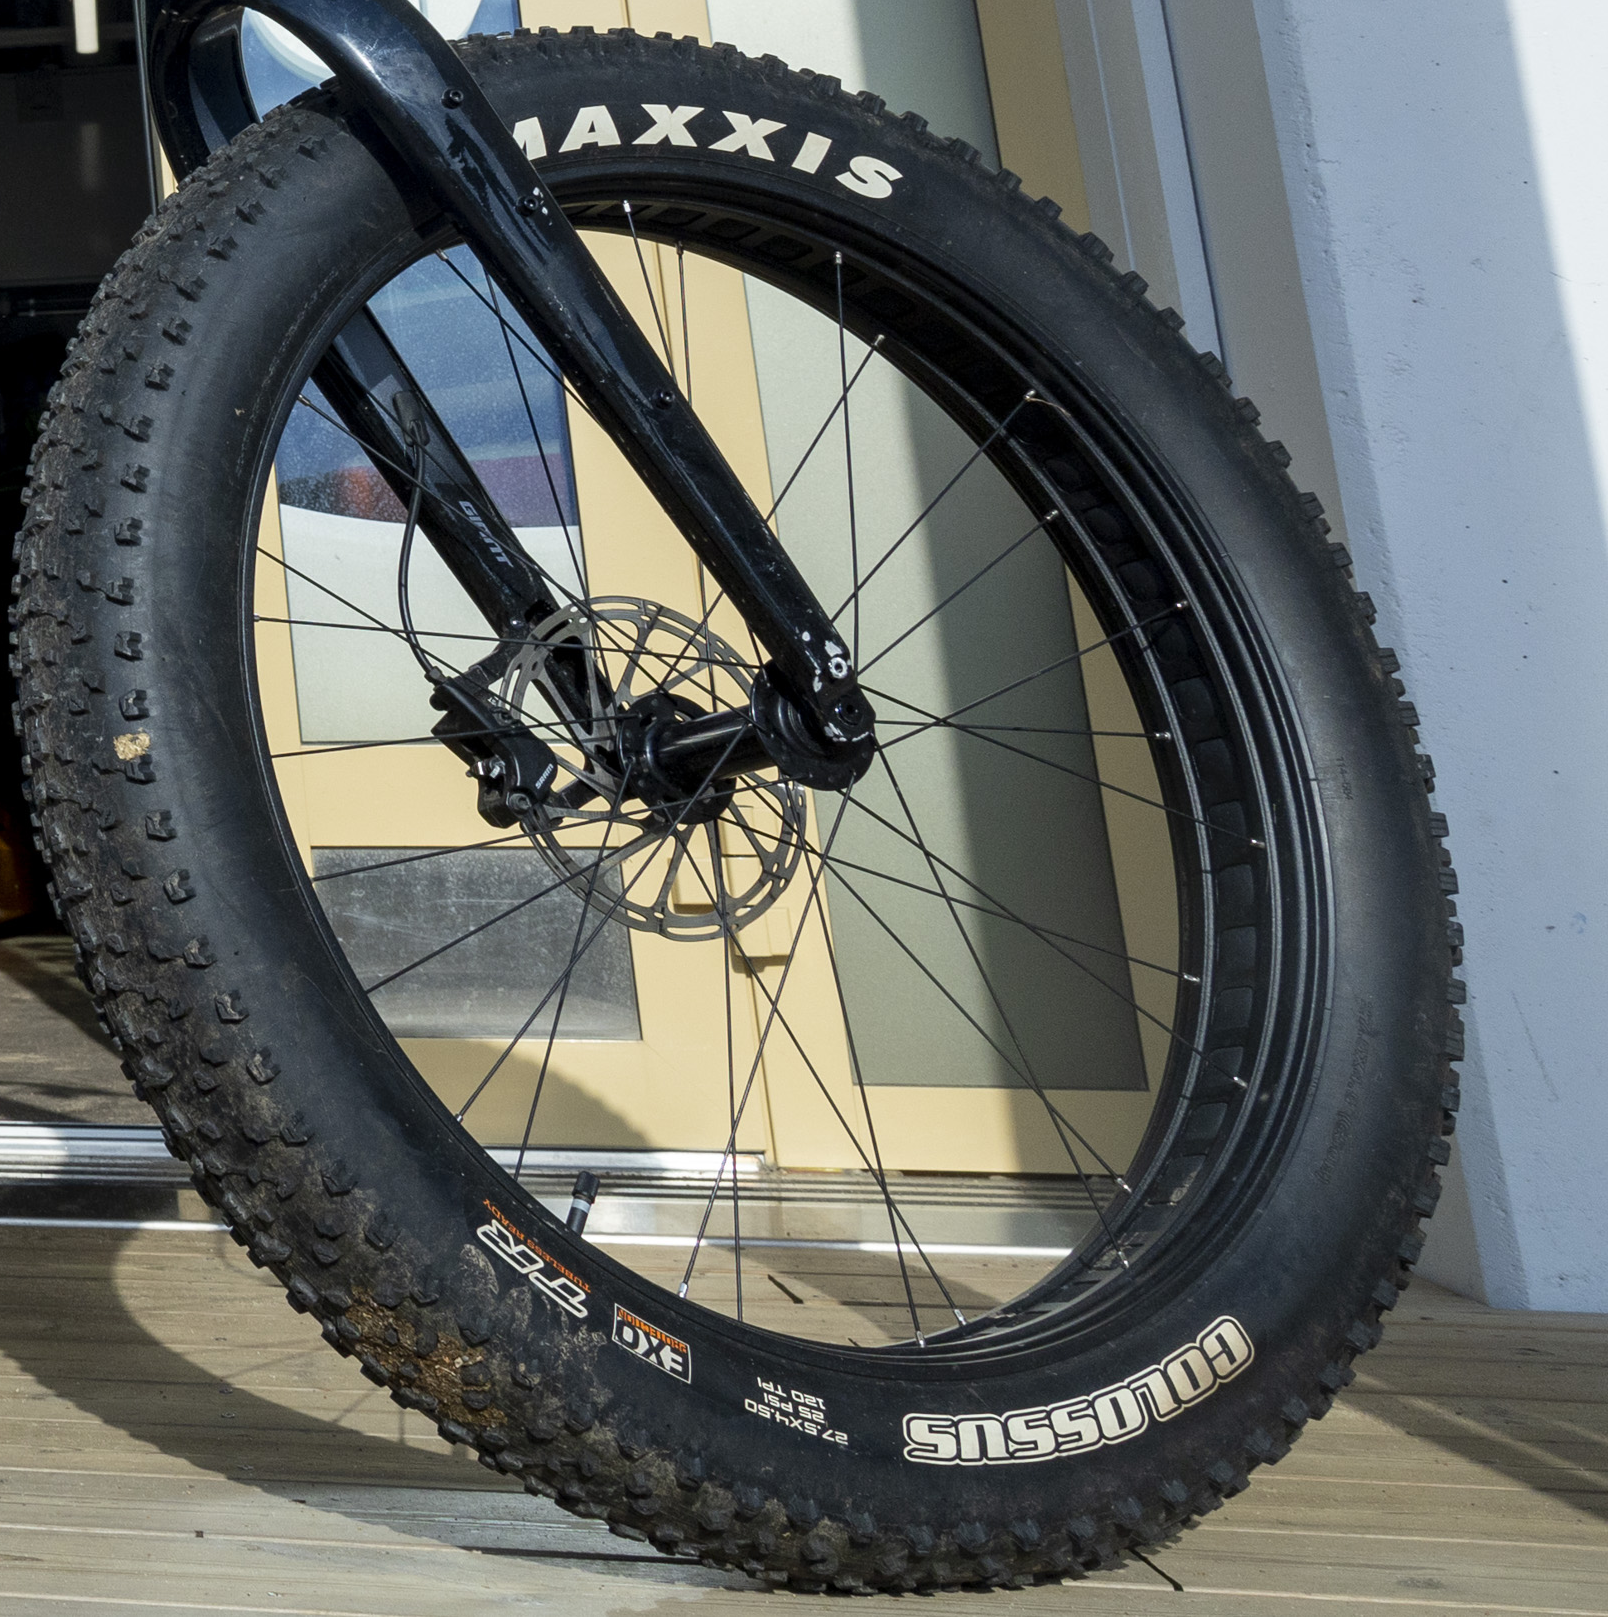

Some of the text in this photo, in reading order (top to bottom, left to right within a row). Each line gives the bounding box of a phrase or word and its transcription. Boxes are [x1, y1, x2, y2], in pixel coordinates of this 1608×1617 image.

[535, 763, 555, 790] SRAM
[483, 1199, 591, 1293] TUBELESS READY
[614, 1316, 686, 1376] EXO
[756, 1377, 825, 1409] 120 TPI
[763, 1393, 825, 1423] 25 PSI
[903, 1315, 1255, 1466] COLOSSUS
